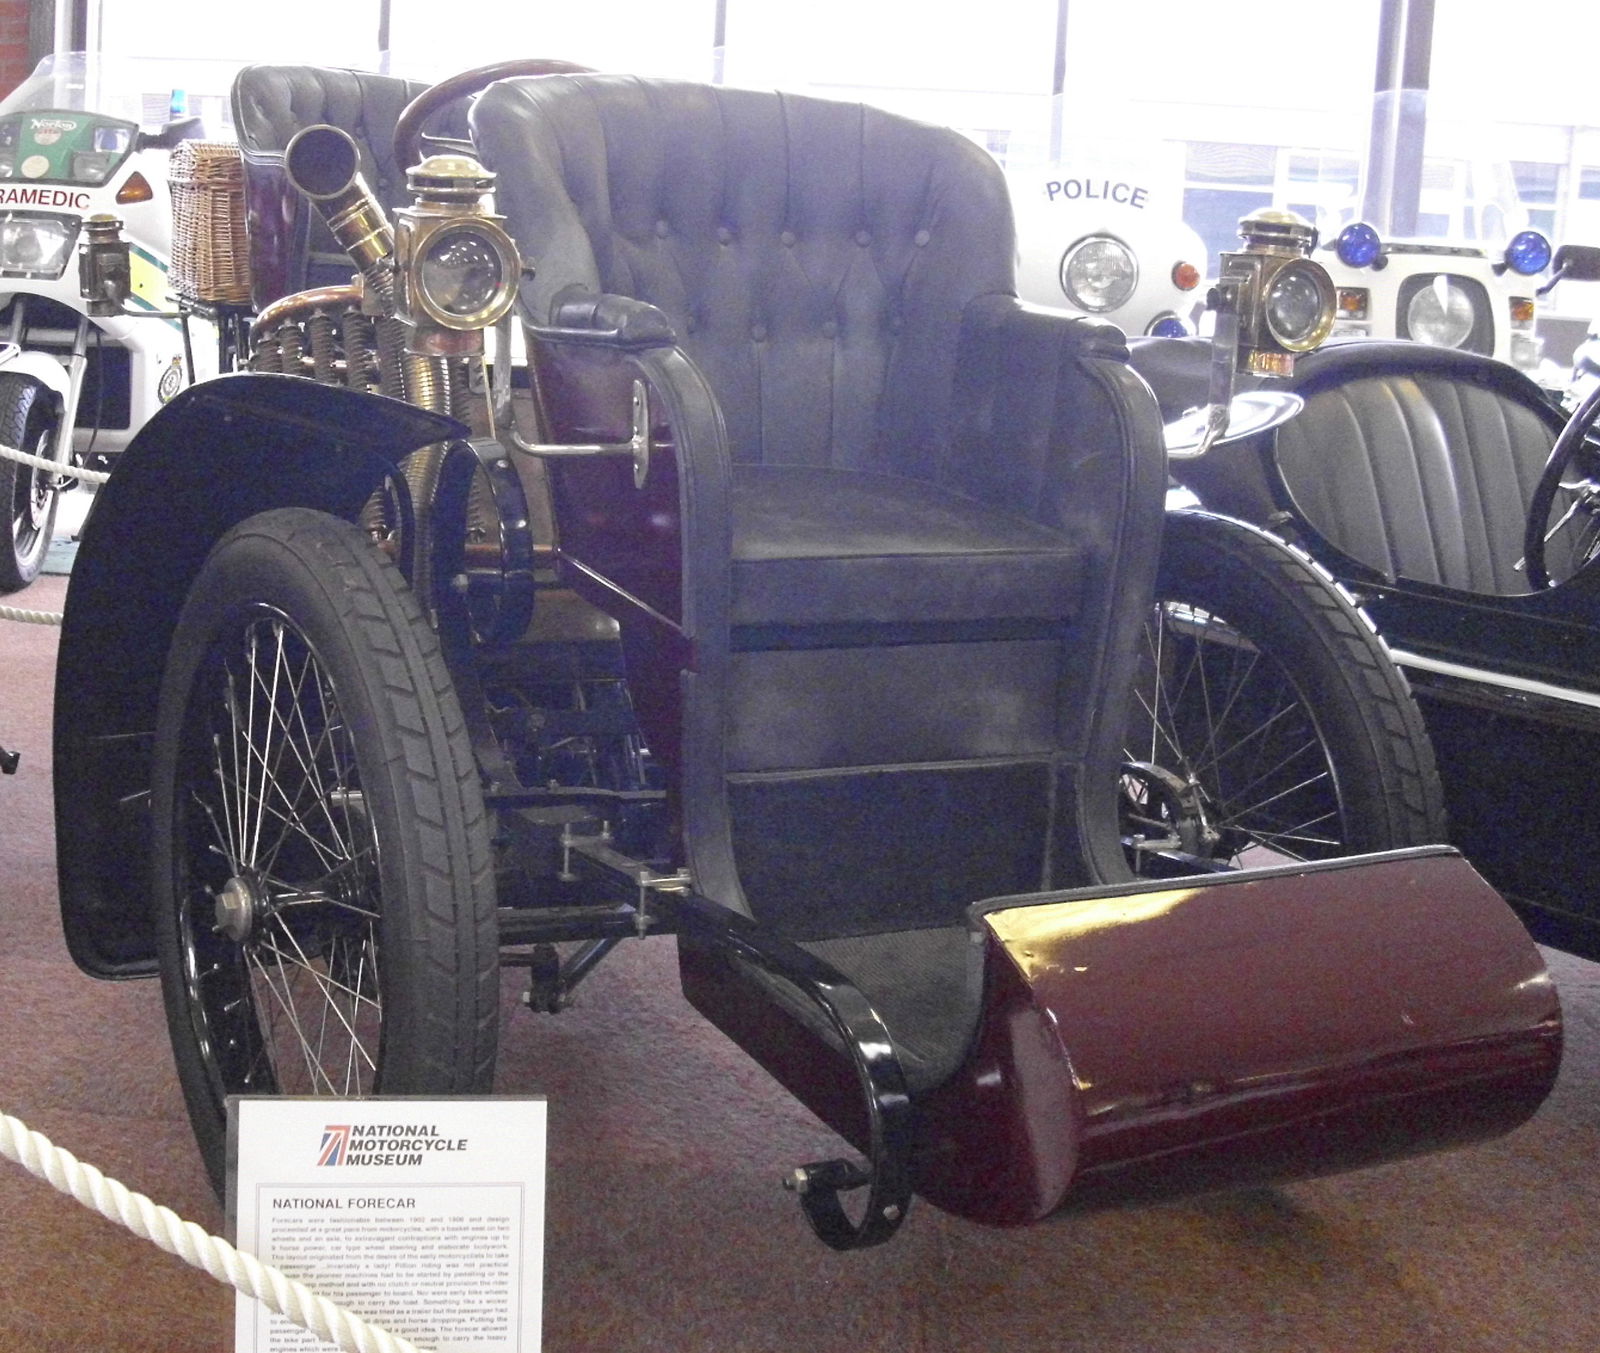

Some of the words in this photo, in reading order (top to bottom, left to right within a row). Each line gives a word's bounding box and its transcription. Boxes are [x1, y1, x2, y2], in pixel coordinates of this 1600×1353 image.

[30, 119, 76, 132] Norton
[1046, 178, 1148, 209] POLICE
[352, 1125, 440, 1136] NATIONAL
[348, 1139, 468, 1151] MOTORCYCLE
[346, 1154, 422, 1166] MUSEUM
[272, 1198, 344, 1209] NATIONAL
[348, 1198, 416, 1209] FORECAR
